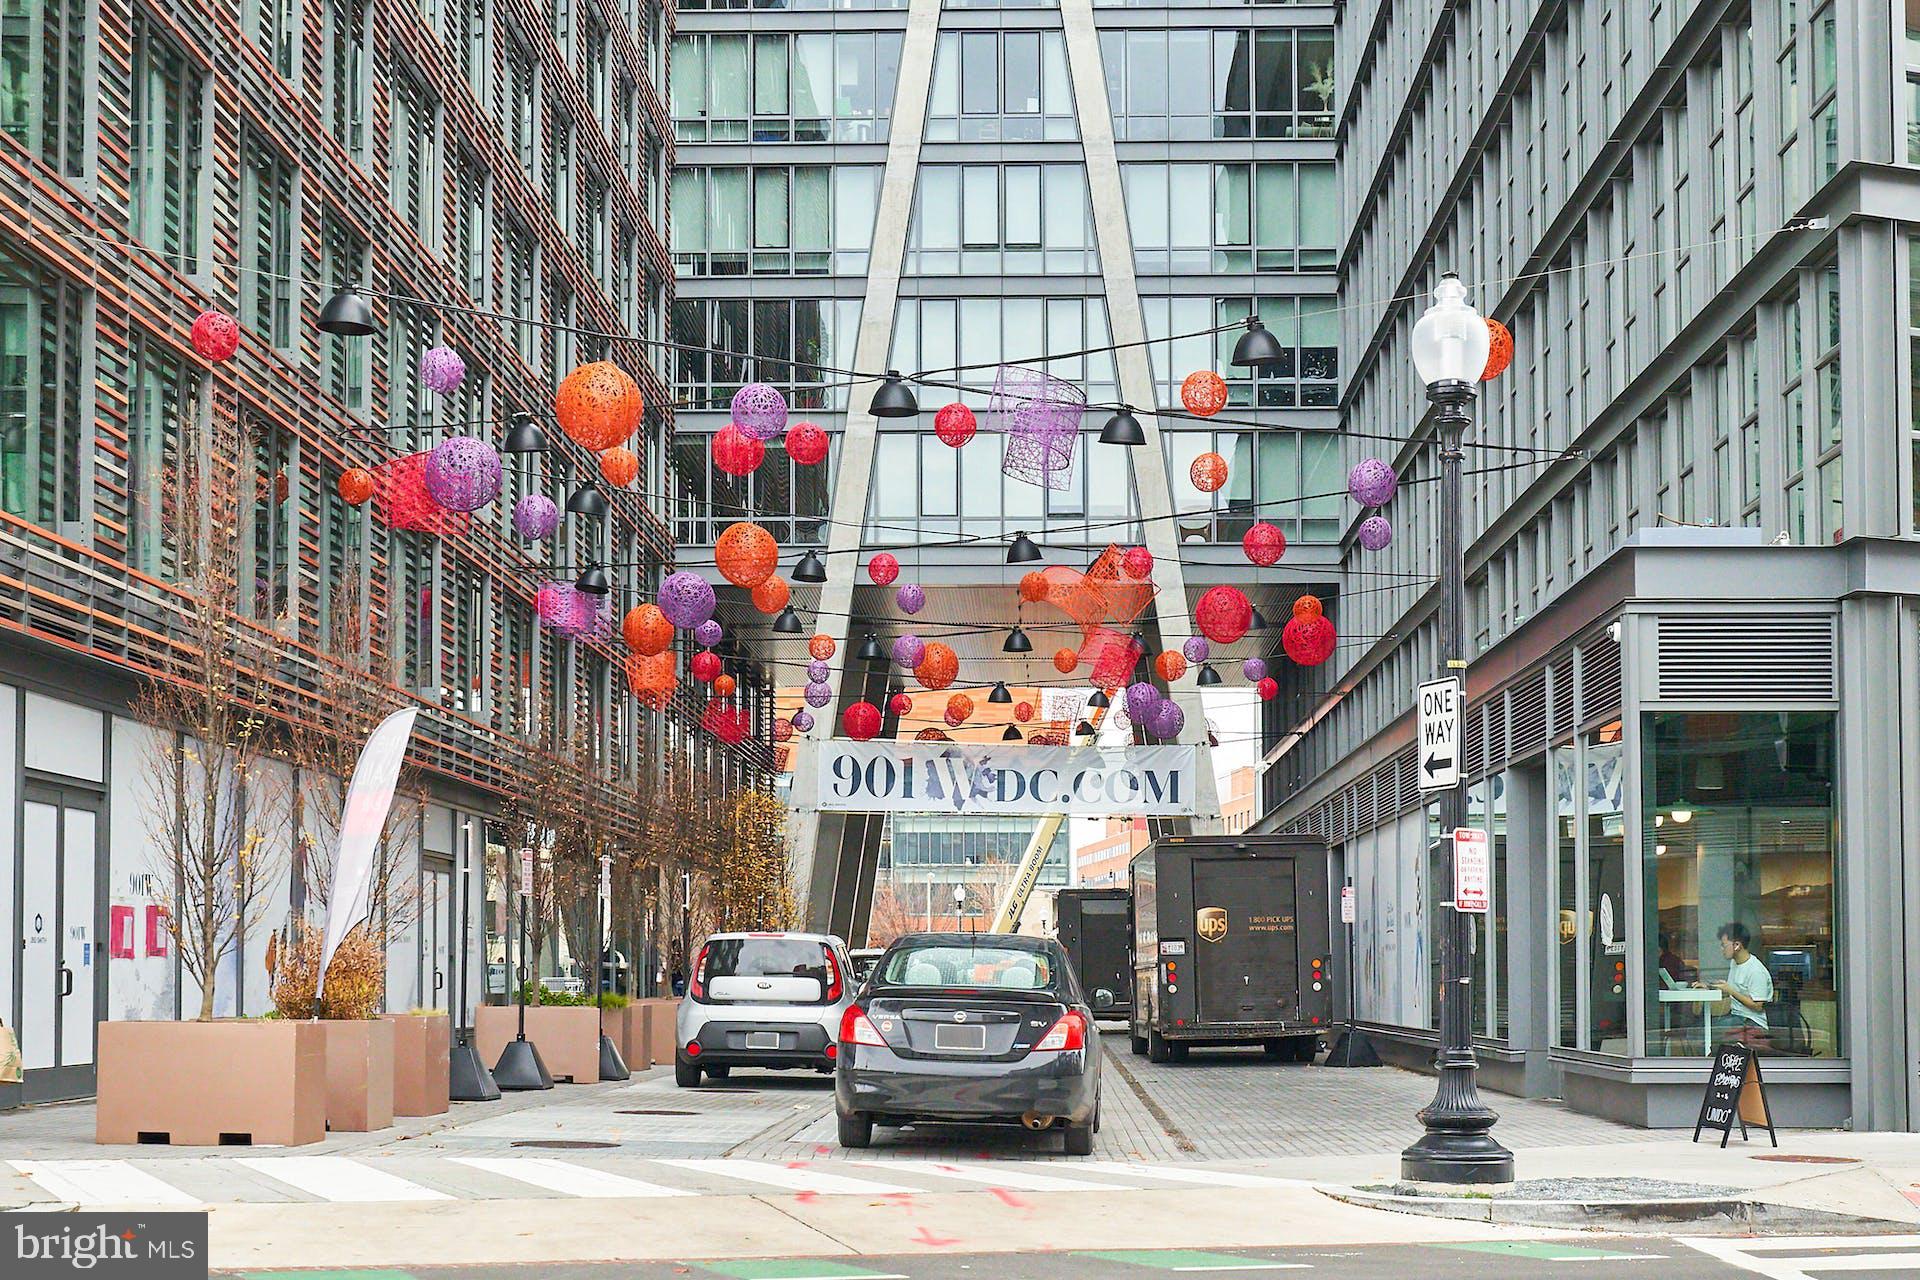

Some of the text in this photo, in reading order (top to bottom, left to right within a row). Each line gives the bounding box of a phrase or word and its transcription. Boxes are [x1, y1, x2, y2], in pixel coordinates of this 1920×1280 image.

[1424, 689, 1453, 717] ONE
[1425, 718, 1455, 746] WAY
[832, 754, 1182, 805] 901WDC.COM
[1008, 846, 1043, 919] JLG ULTRA BOOM
[1200, 917, 1226, 938] ups
[1030, 1020, 1048, 1028] SV
